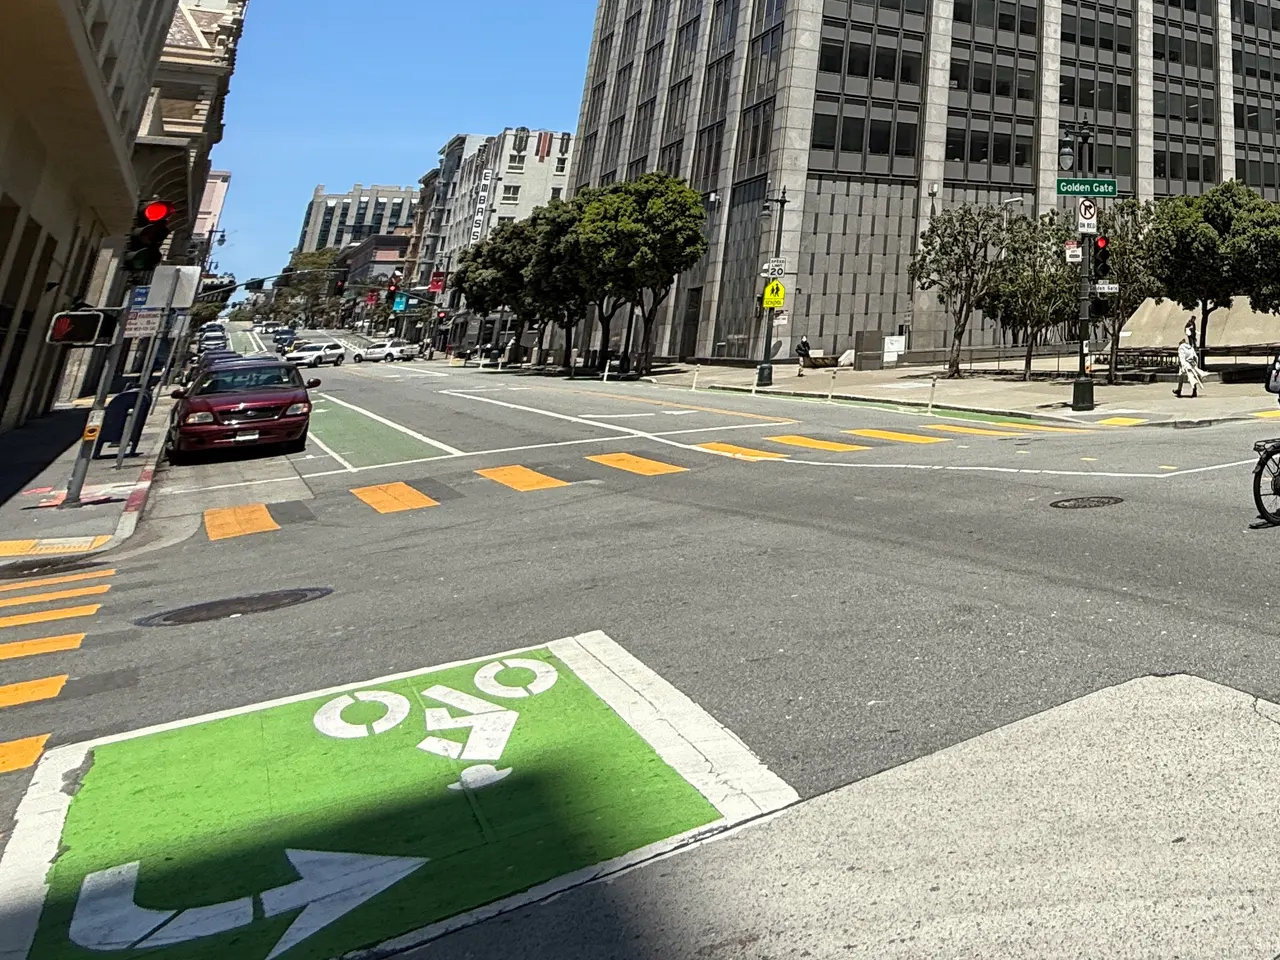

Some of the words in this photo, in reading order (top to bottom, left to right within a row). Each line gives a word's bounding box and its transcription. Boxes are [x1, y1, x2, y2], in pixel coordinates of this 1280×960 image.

[1060, 182, 1090, 192] Golden
[1093, 183, 1113, 193] Gate
[469, 172, 491, 245] EMBASS
[770, 267, 784, 276] 20
